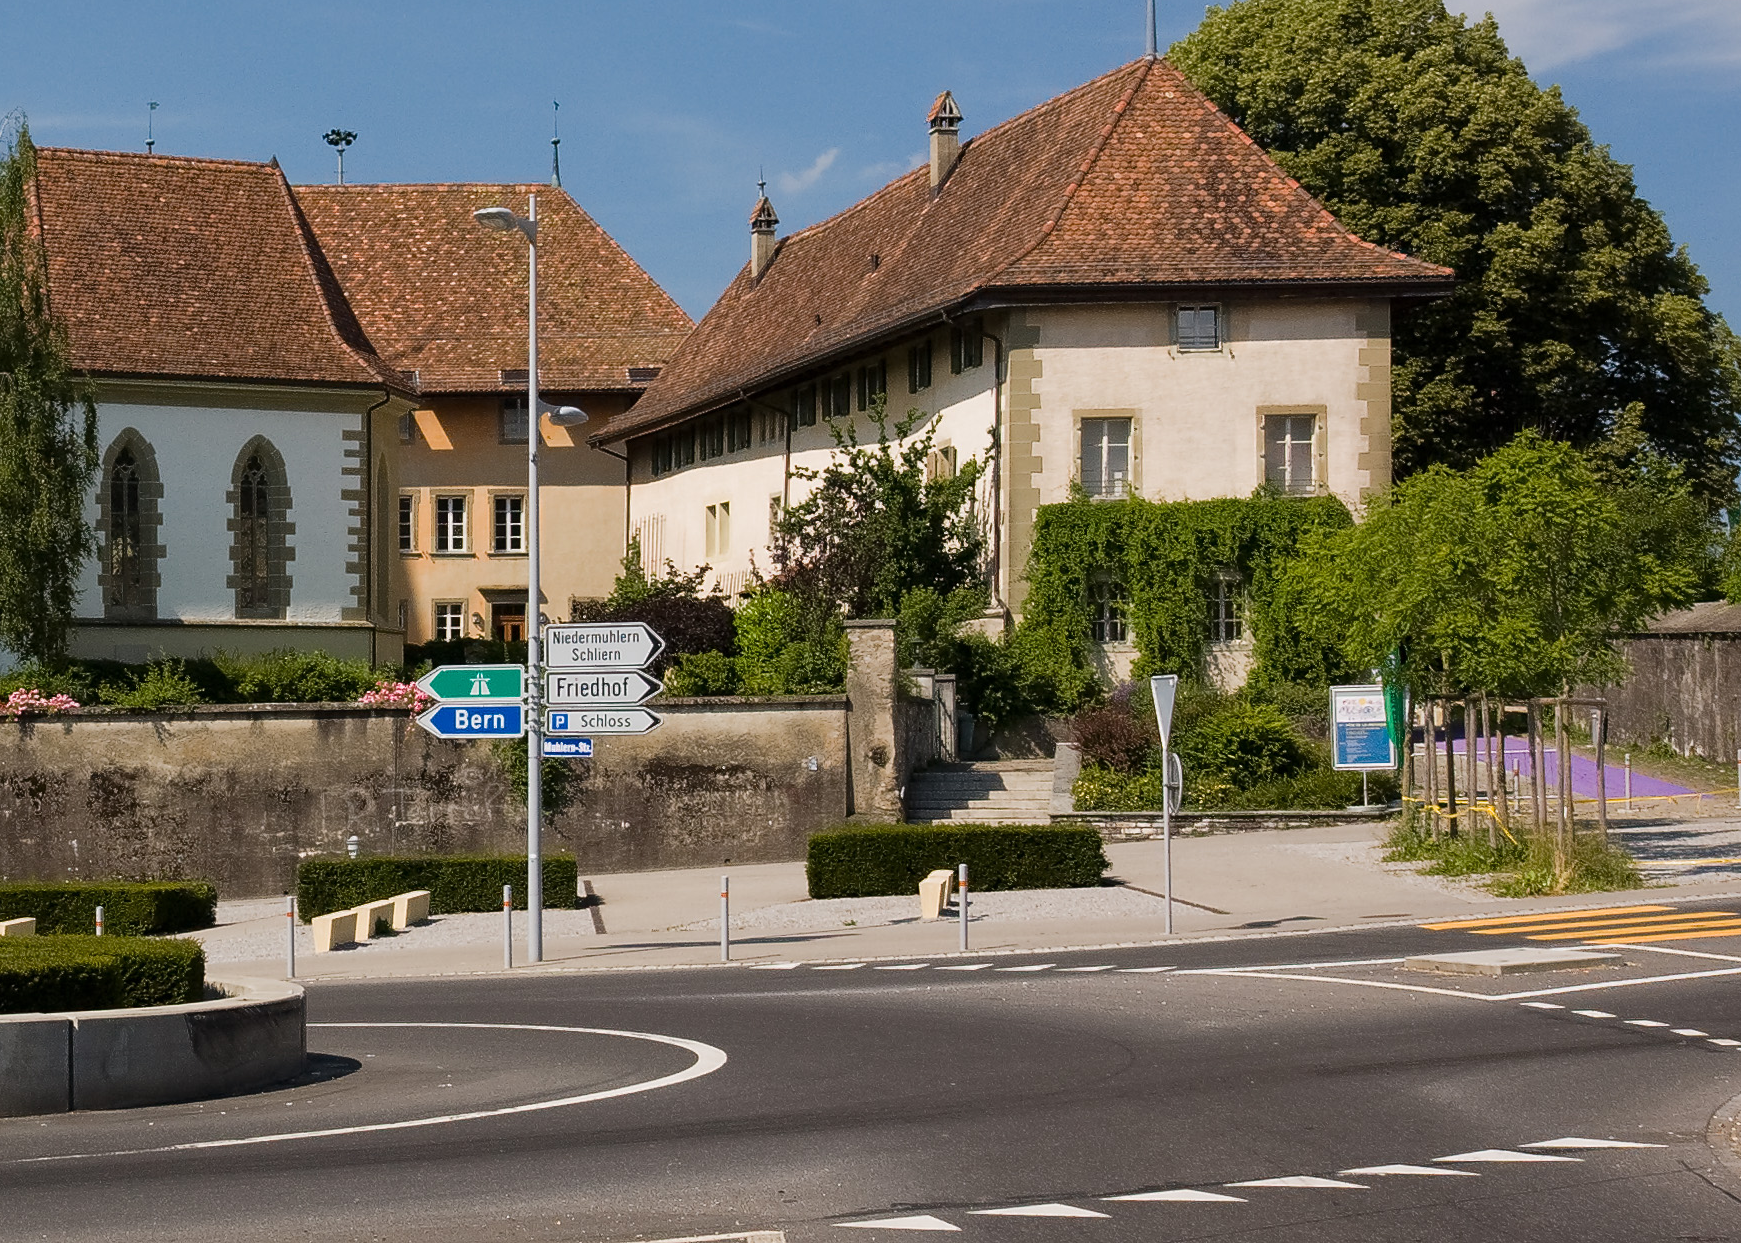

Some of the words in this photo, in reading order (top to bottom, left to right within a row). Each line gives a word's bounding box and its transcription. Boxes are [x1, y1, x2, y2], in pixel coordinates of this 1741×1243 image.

[552, 630, 640, 645] Niedermuhlern
[571, 648, 621, 661] Schliern
[556, 677, 630, 697] Friedhof
[455, 709, 505, 729] Bern
[581, 714, 631, 728] Schloss
